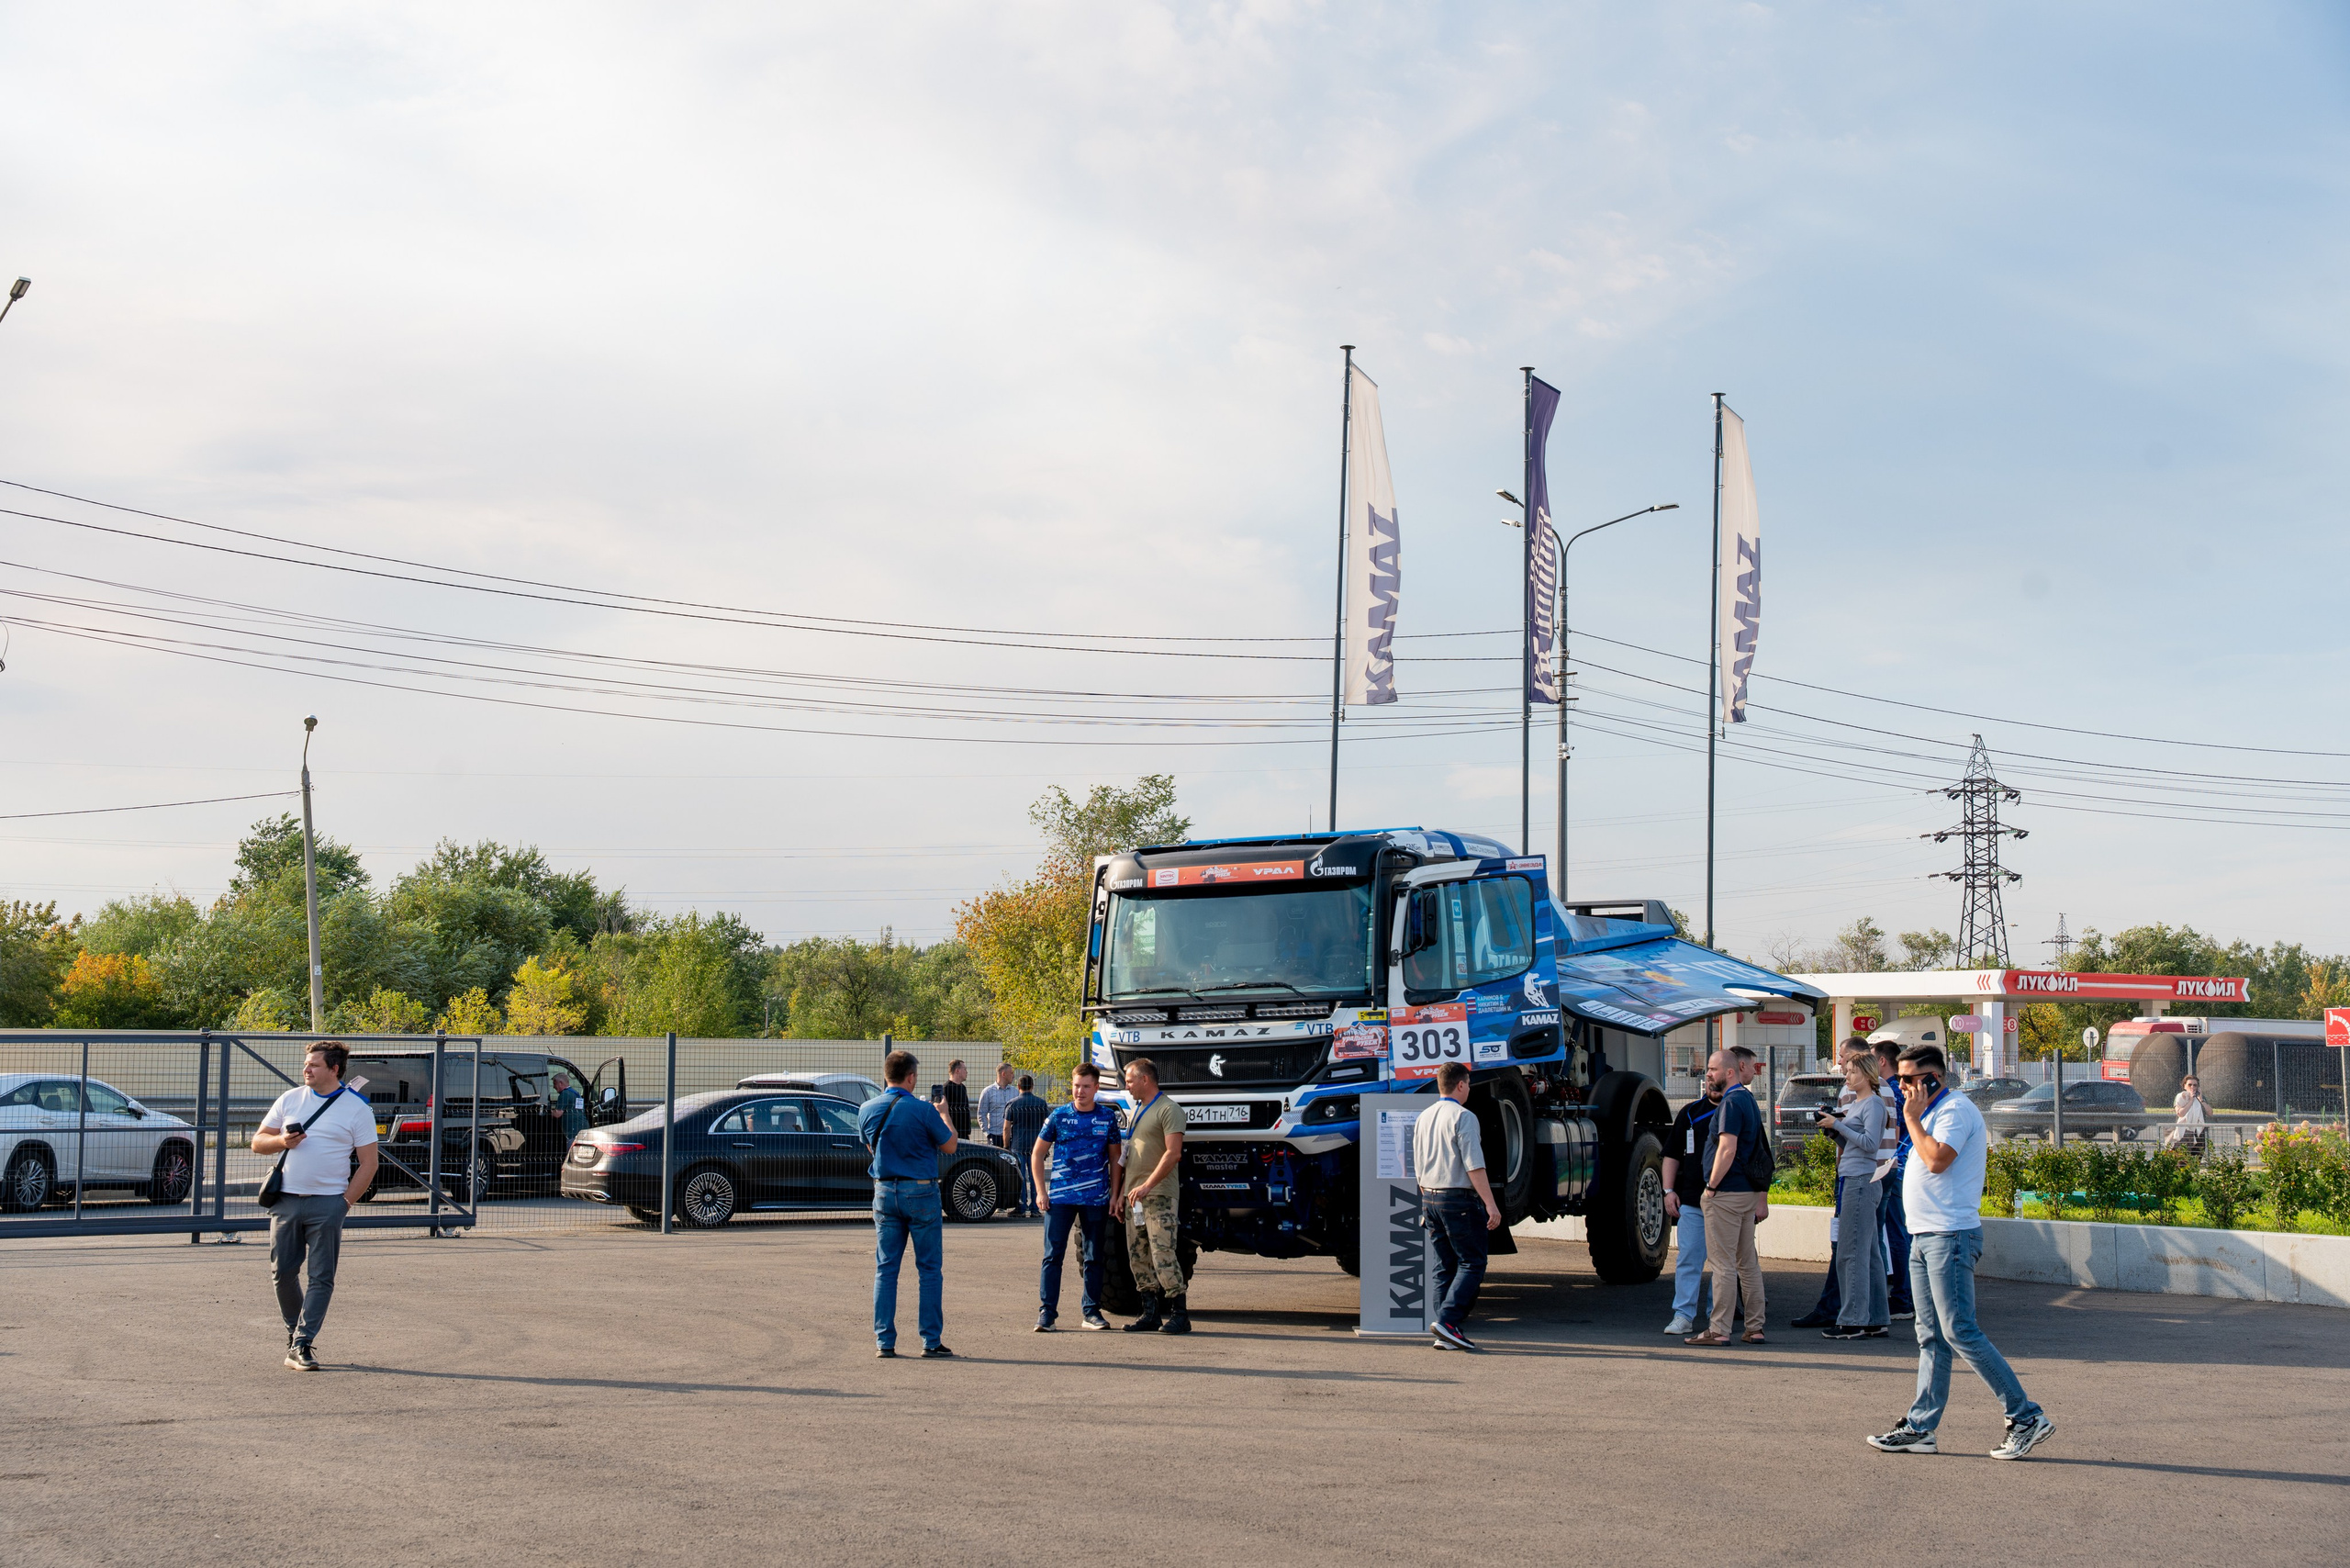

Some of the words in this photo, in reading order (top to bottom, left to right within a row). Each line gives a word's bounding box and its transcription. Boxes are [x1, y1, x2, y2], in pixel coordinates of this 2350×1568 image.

[1367, 501, 1401, 705] KAMAZ
[1253, 867, 1294, 876] УРАЛ
[1325, 866, 1357, 876] ГАЗПРОМ
[1117, 879, 1143, 889] ГАЗПРОМ
[2017, 972, 2078, 992] ЛУКОЙЛ
[2177, 978, 2235, 997] ЛУКОЙЛ
[1478, 1006, 1506, 1014] ДАВЛЕТШИН
[1521, 1014, 1560, 1026] KAMAZ
[1953, 1019, 1964, 1028] 10
[1160, 1027, 1270, 1039] KAMAZ
[1306, 1023, 1334, 1036] VTB
[1118, 1031, 1140, 1043] VTB
[1401, 1027, 1461, 1061] 303
[1413, 1068, 1438, 1076] УРА
[1185, 1108, 1226, 1122] 841ТН
[1229, 1106, 1246, 1117] 716
[1192, 1153, 1248, 1164] KAMAZ
[1390, 1184, 1424, 1318] KAMAZ
